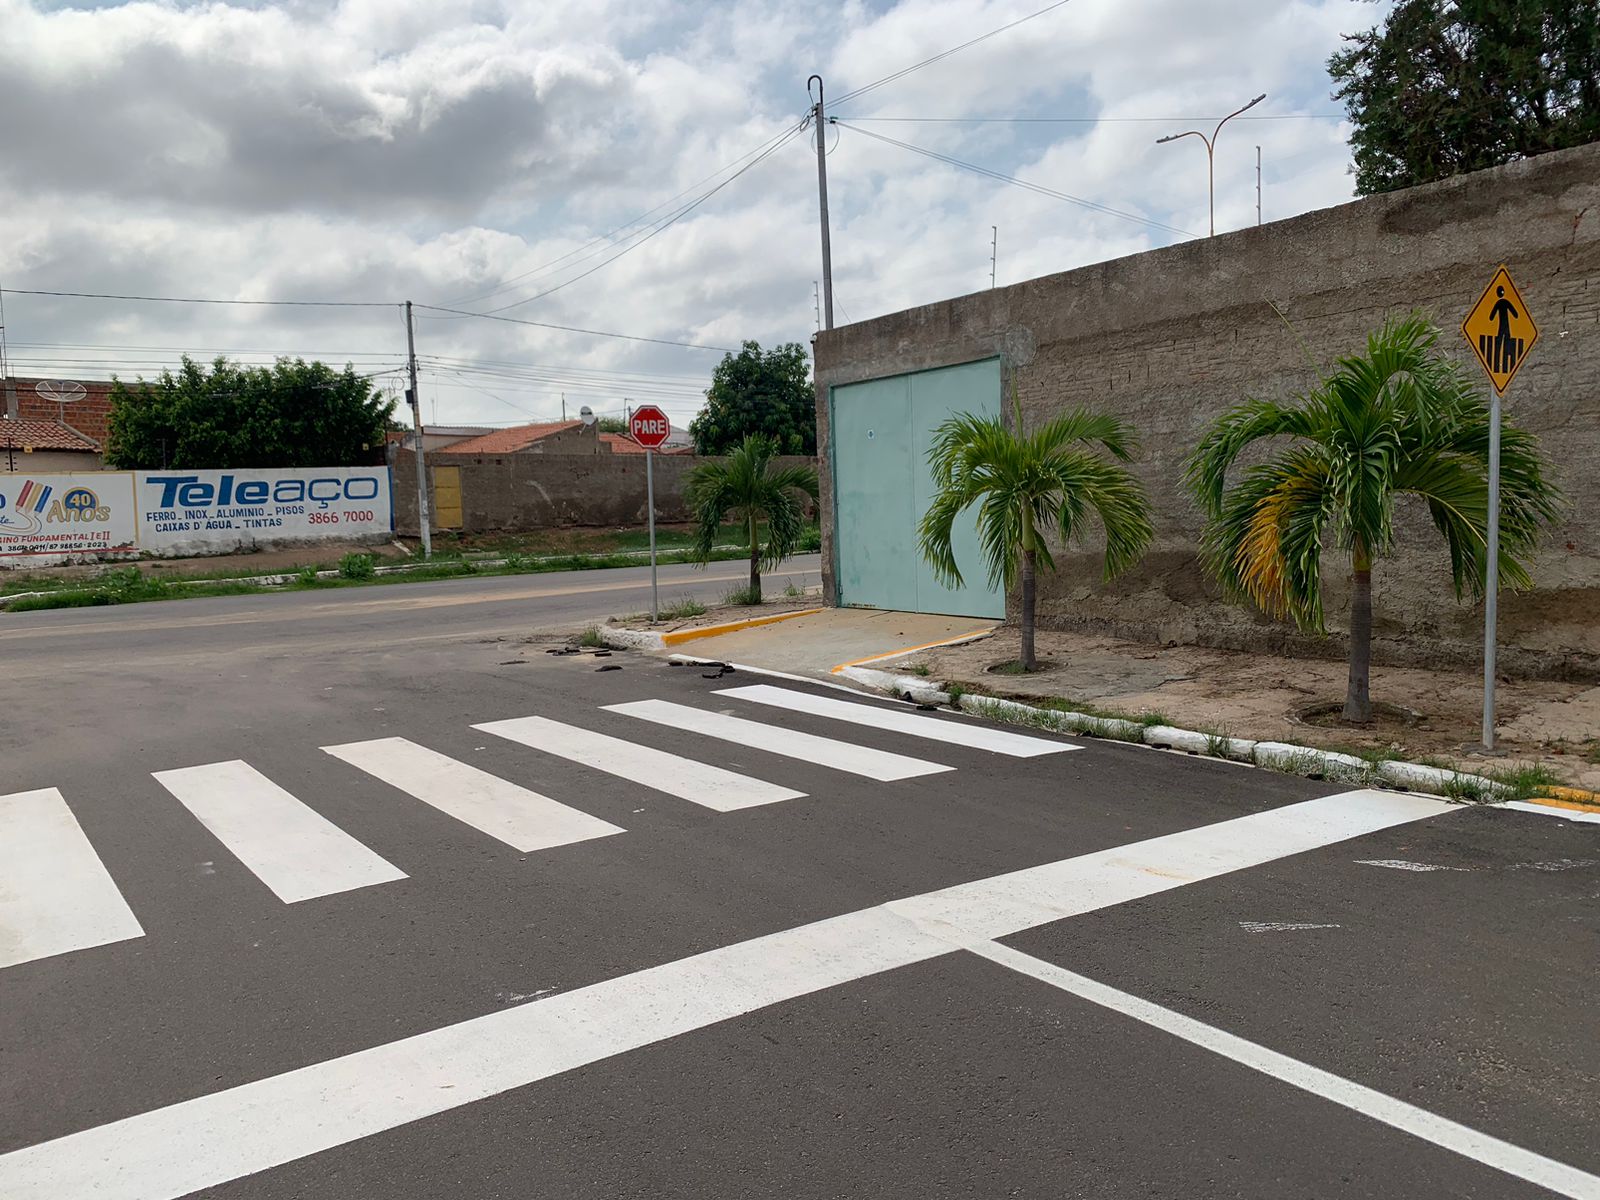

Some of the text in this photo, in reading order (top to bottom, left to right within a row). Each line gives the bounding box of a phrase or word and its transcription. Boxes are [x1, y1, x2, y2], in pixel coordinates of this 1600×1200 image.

[634, 420, 666, 434] PARE
[146, 475, 378, 509] Teleaço
[69, 494, 91, 506] 40
[47, 500, 111, 523] Anos
[146, 506, 305, 521] FERRO INOX ALUMINIO PISOS
[308, 511, 374, 524] 3866 7000
[155, 522, 190, 532] CAIXAS
[243, 519, 282, 528] TINTAS
[21, 533, 89, 543] FUNDAMENTAL
